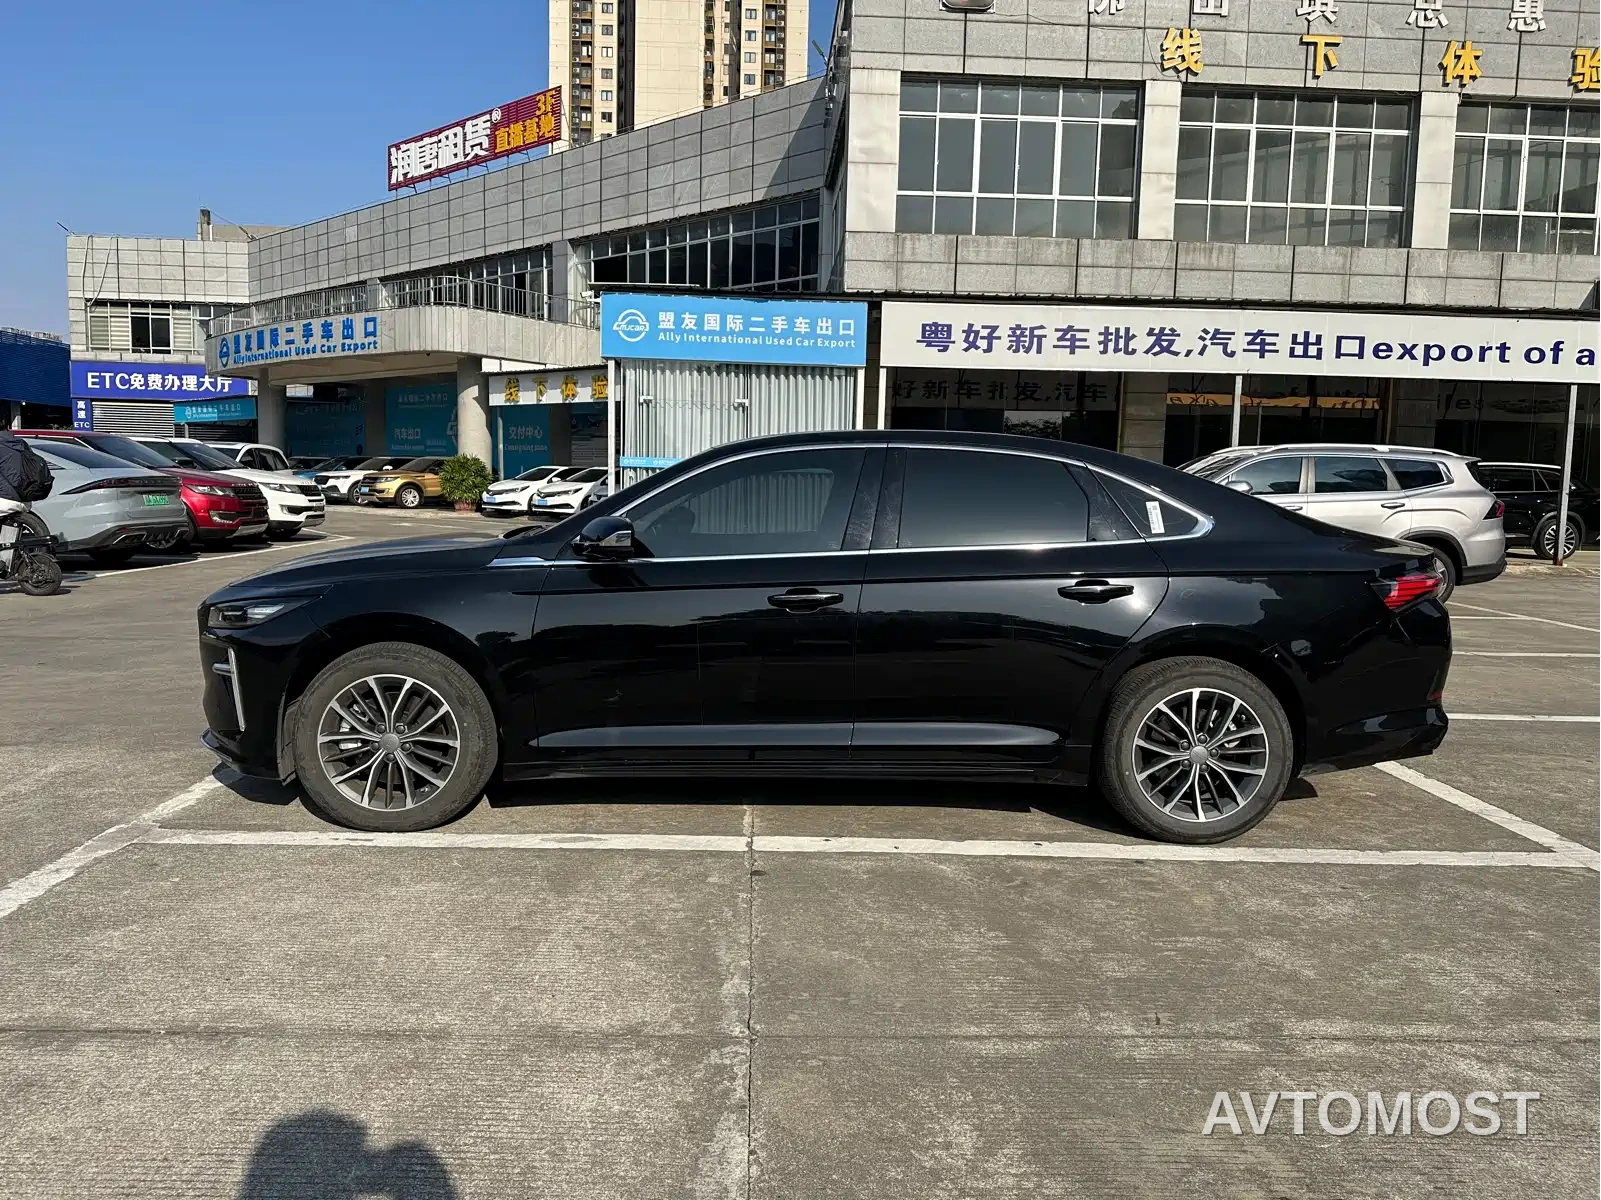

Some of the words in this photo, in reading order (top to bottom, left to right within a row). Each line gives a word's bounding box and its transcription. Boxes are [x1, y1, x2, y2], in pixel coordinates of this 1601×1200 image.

[1161, 27, 1601, 92] 线下体验
[536, 90, 555, 115] 3F
[495, 112, 555, 153] 直播基地
[658, 311, 855, 336] 盟友国际二手车出口
[295, 344, 317, 356] Used
[320, 344, 337, 354] Car
[341, 339, 378, 353] Export
[658, 332, 681, 344] Ally
[684, 332, 763, 345] International
[765, 336, 793, 346] Used
[796, 337, 814, 347] Car
[817, 338, 855, 349] Export
[1523, 340, 1565, 365] of
[87, 371, 233, 393] ETC免费办理大厅
[508, 425, 543, 440] 交付中心
